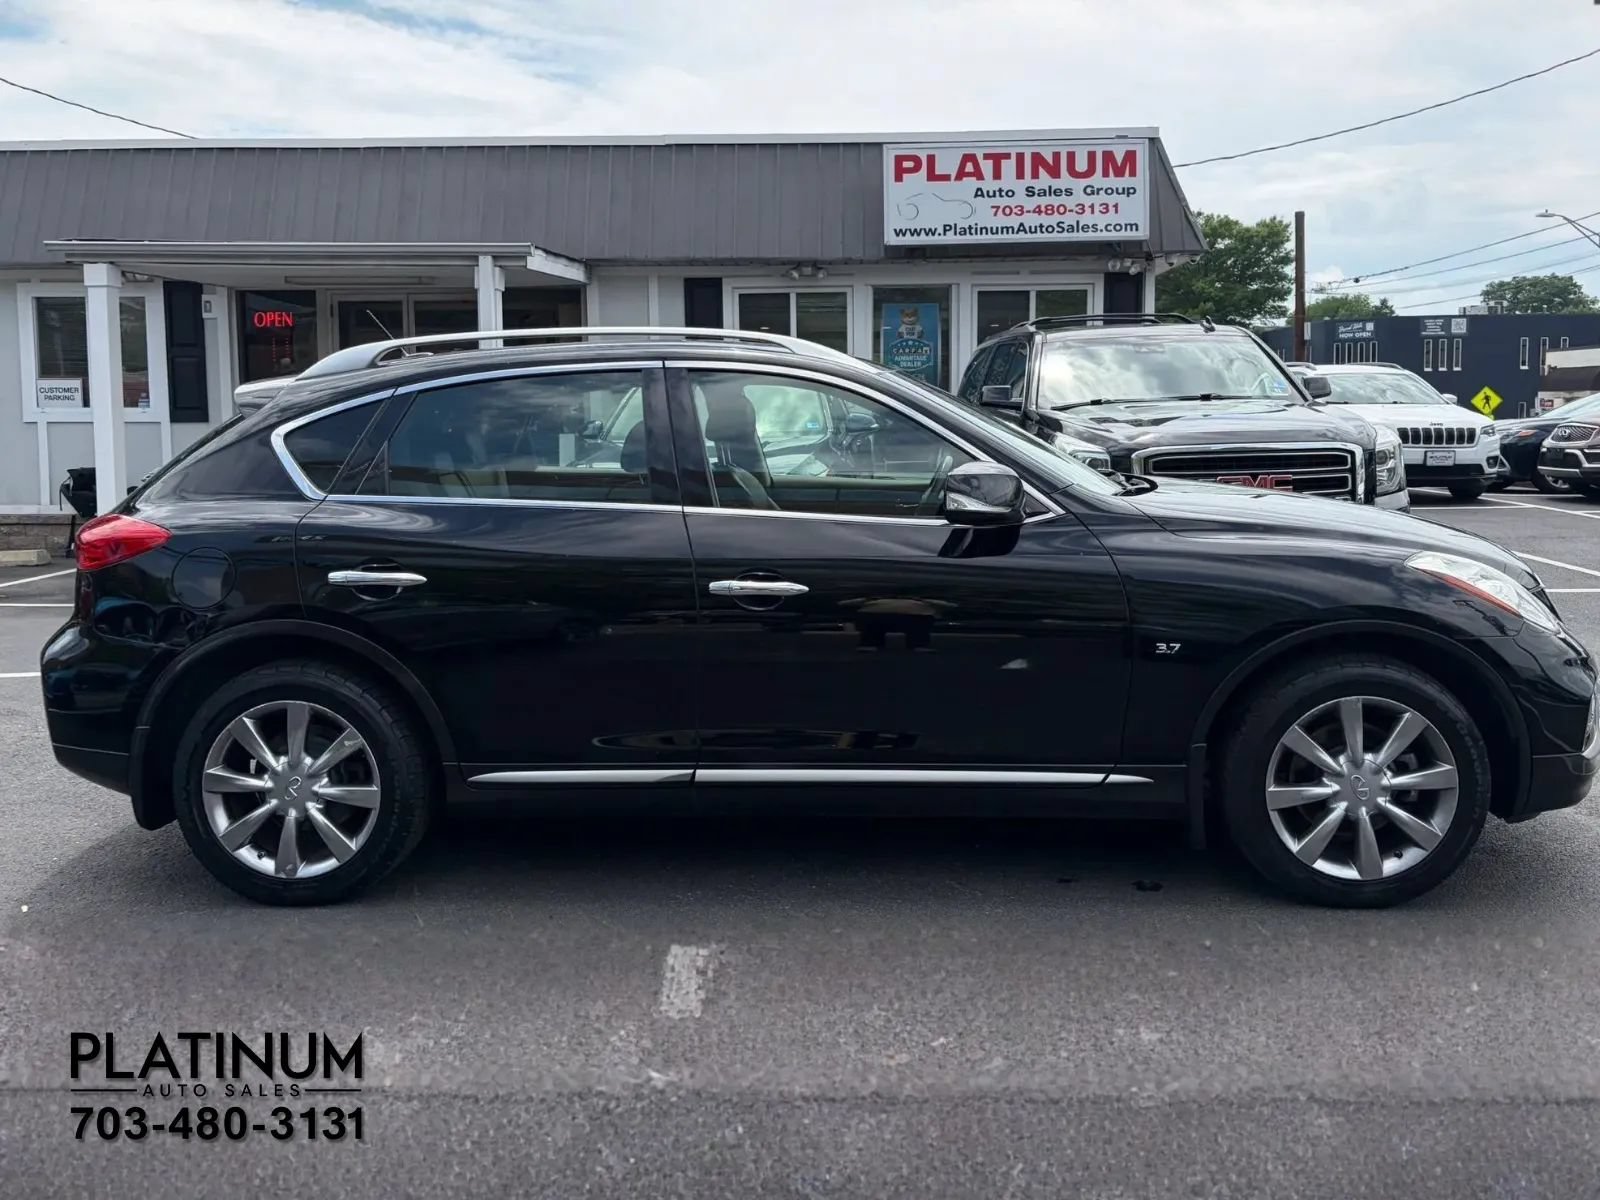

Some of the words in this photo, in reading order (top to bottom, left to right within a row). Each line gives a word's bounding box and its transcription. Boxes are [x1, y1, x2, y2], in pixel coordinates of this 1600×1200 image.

[894, 150, 1137, 183] PLATINUM
[973, 187, 1016, 199] Auto
[1024, 185, 1074, 198] Sales
[1082, 184, 1138, 199] Group
[990, 202, 1120, 217] 703-480-3131
[893, 221, 1139, 238] www.PlatinumAutoSales.com
[254, 311, 294, 328] OPEN
[39, 386, 80, 394] CUSTOMER
[1155, 642, 1181, 654] 3.7
